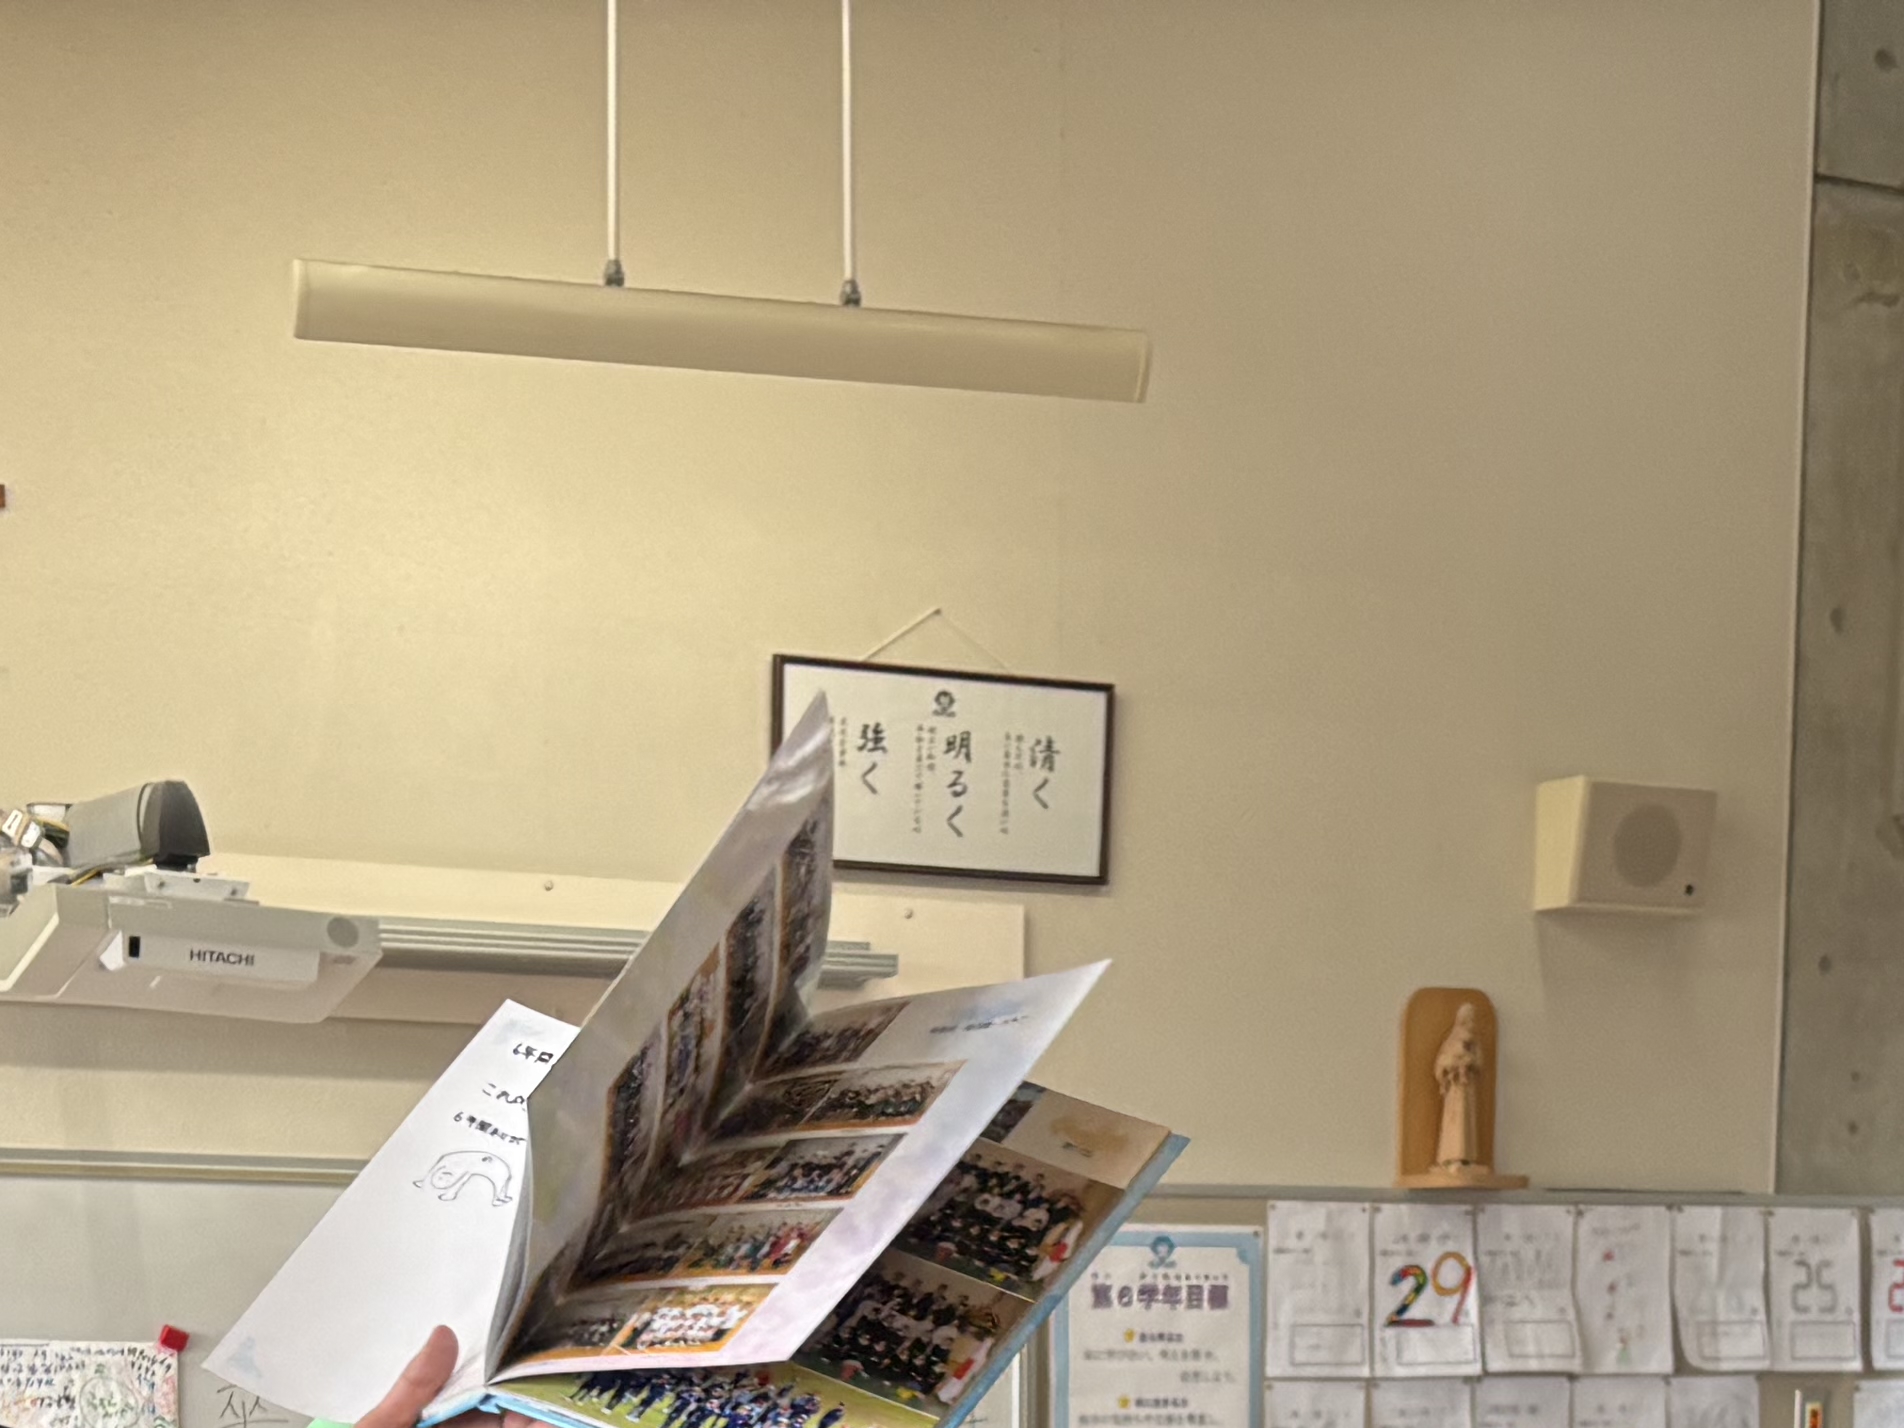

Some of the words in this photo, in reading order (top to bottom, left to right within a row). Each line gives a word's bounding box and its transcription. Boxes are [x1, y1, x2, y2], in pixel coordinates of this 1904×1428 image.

[856, 722, 889, 795] 強く
[942, 731, 973, 838] 明るく
[1028, 735, 1060, 810] 清く
[189, 948, 255, 966] HITACHI
[1383, 1250, 1476, 1328] 29
[1791, 1259, 1839, 1315] 25
